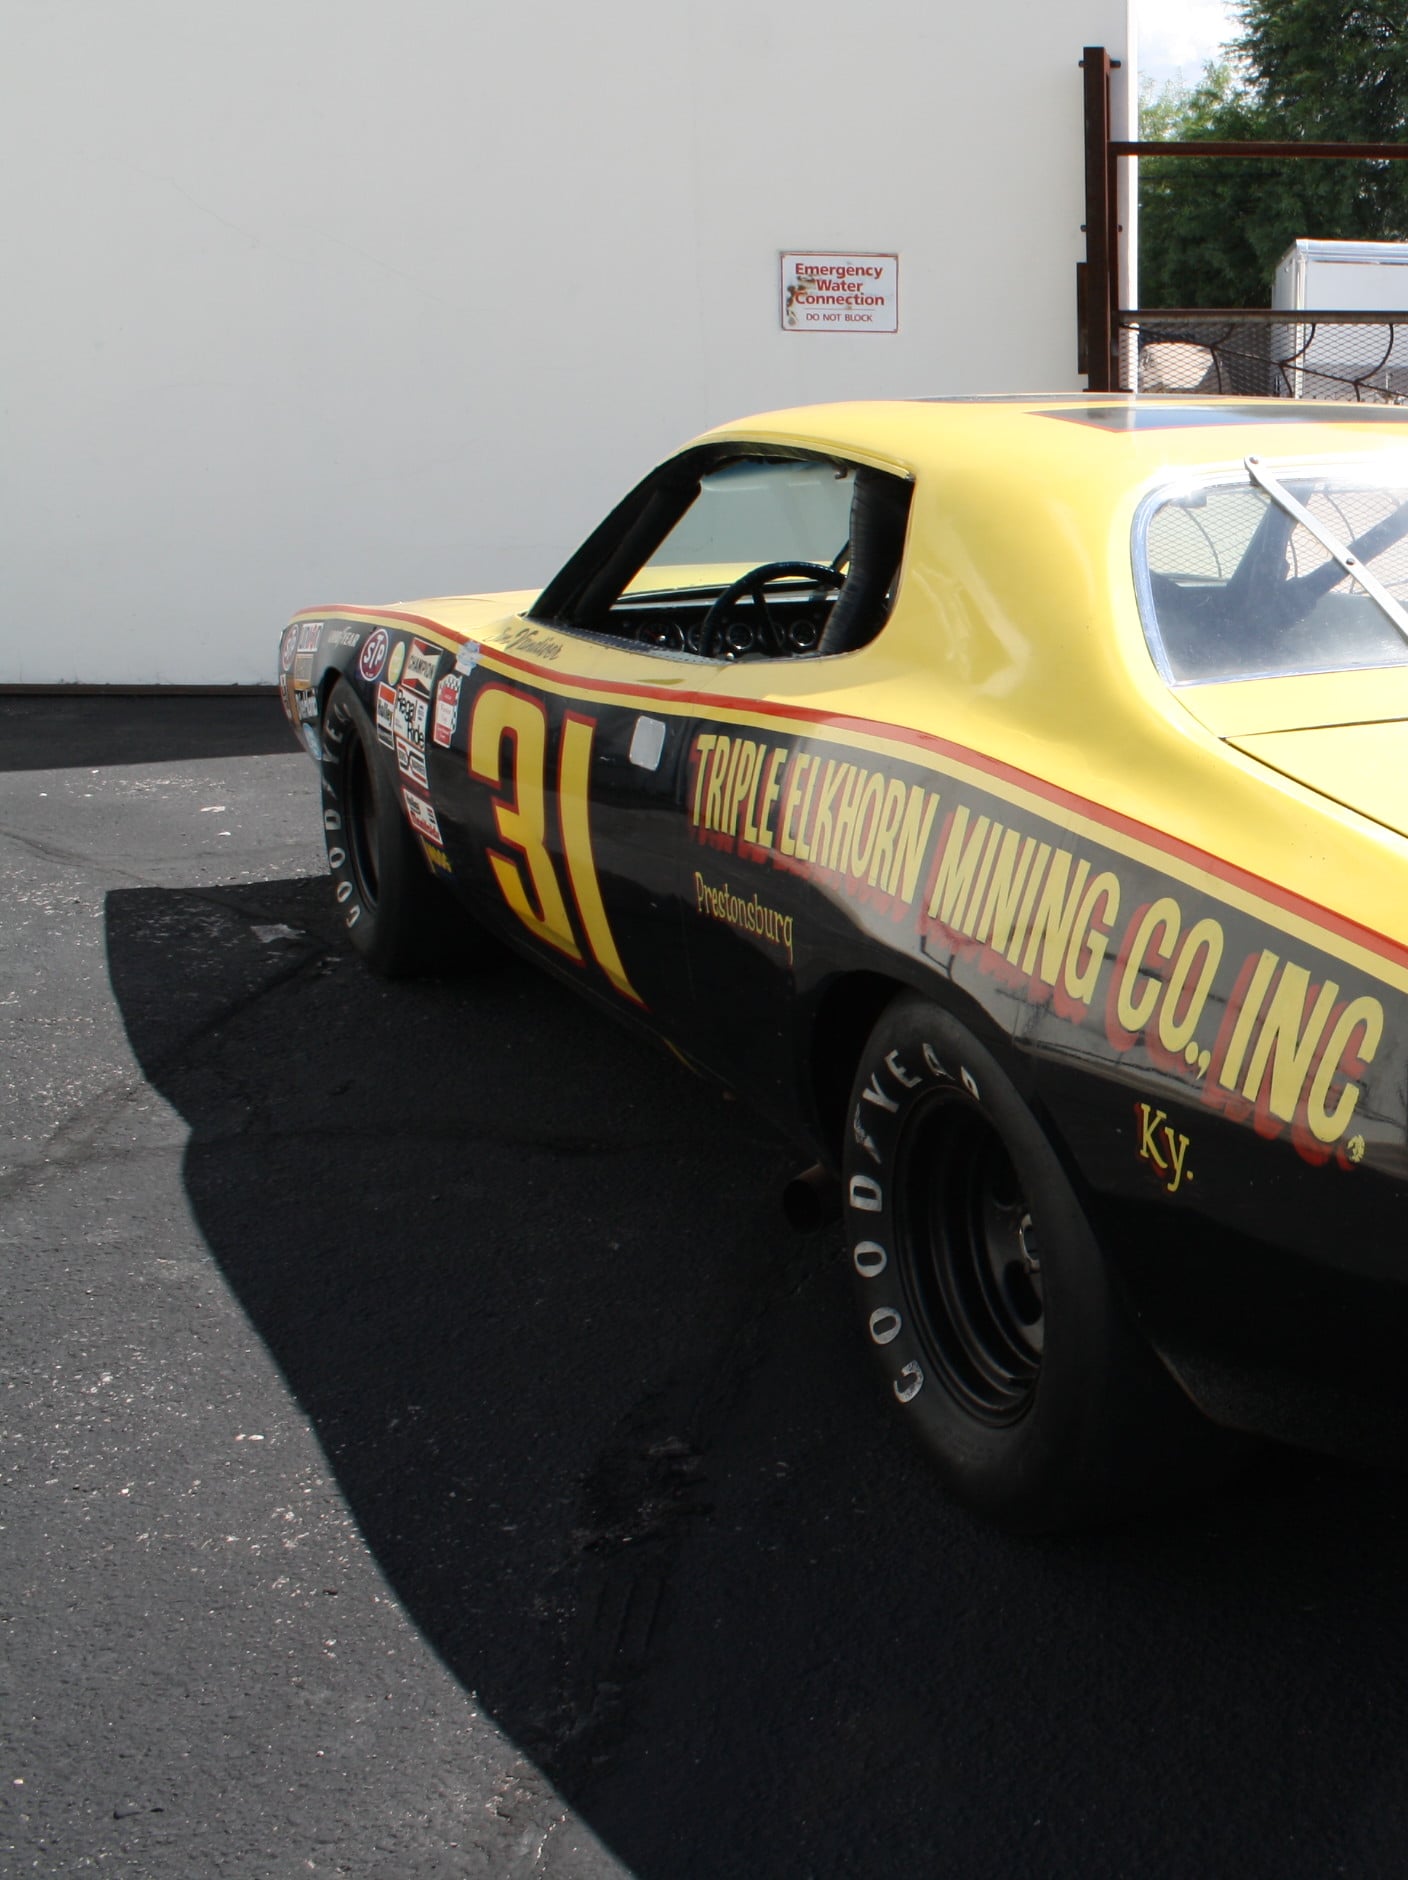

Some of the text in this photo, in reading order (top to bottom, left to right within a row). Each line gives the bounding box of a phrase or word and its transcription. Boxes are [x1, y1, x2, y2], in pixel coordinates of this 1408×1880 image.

[795, 263, 883, 279] Emergency
[816, 279, 863, 292] Water
[795, 293, 885, 306] Connection
[806, 313, 873, 322] DO NOT BLOCK
[363, 634, 385, 669] STP
[408, 655, 435, 679] CHAMPION
[398, 688, 417, 722] Regal
[408, 721, 426, 751] Ride
[468, 682, 652, 1013] 31
[694, 871, 793, 966] Prestonsburg
[691, 734, 788, 850] TRIPLE
[779, 752, 940, 905] ELKHORN
[925, 804, 1121, 1006] MINING
[1218, 948, 1384, 1163] INC.
[1137, 1103, 1194, 1192] Ky.
